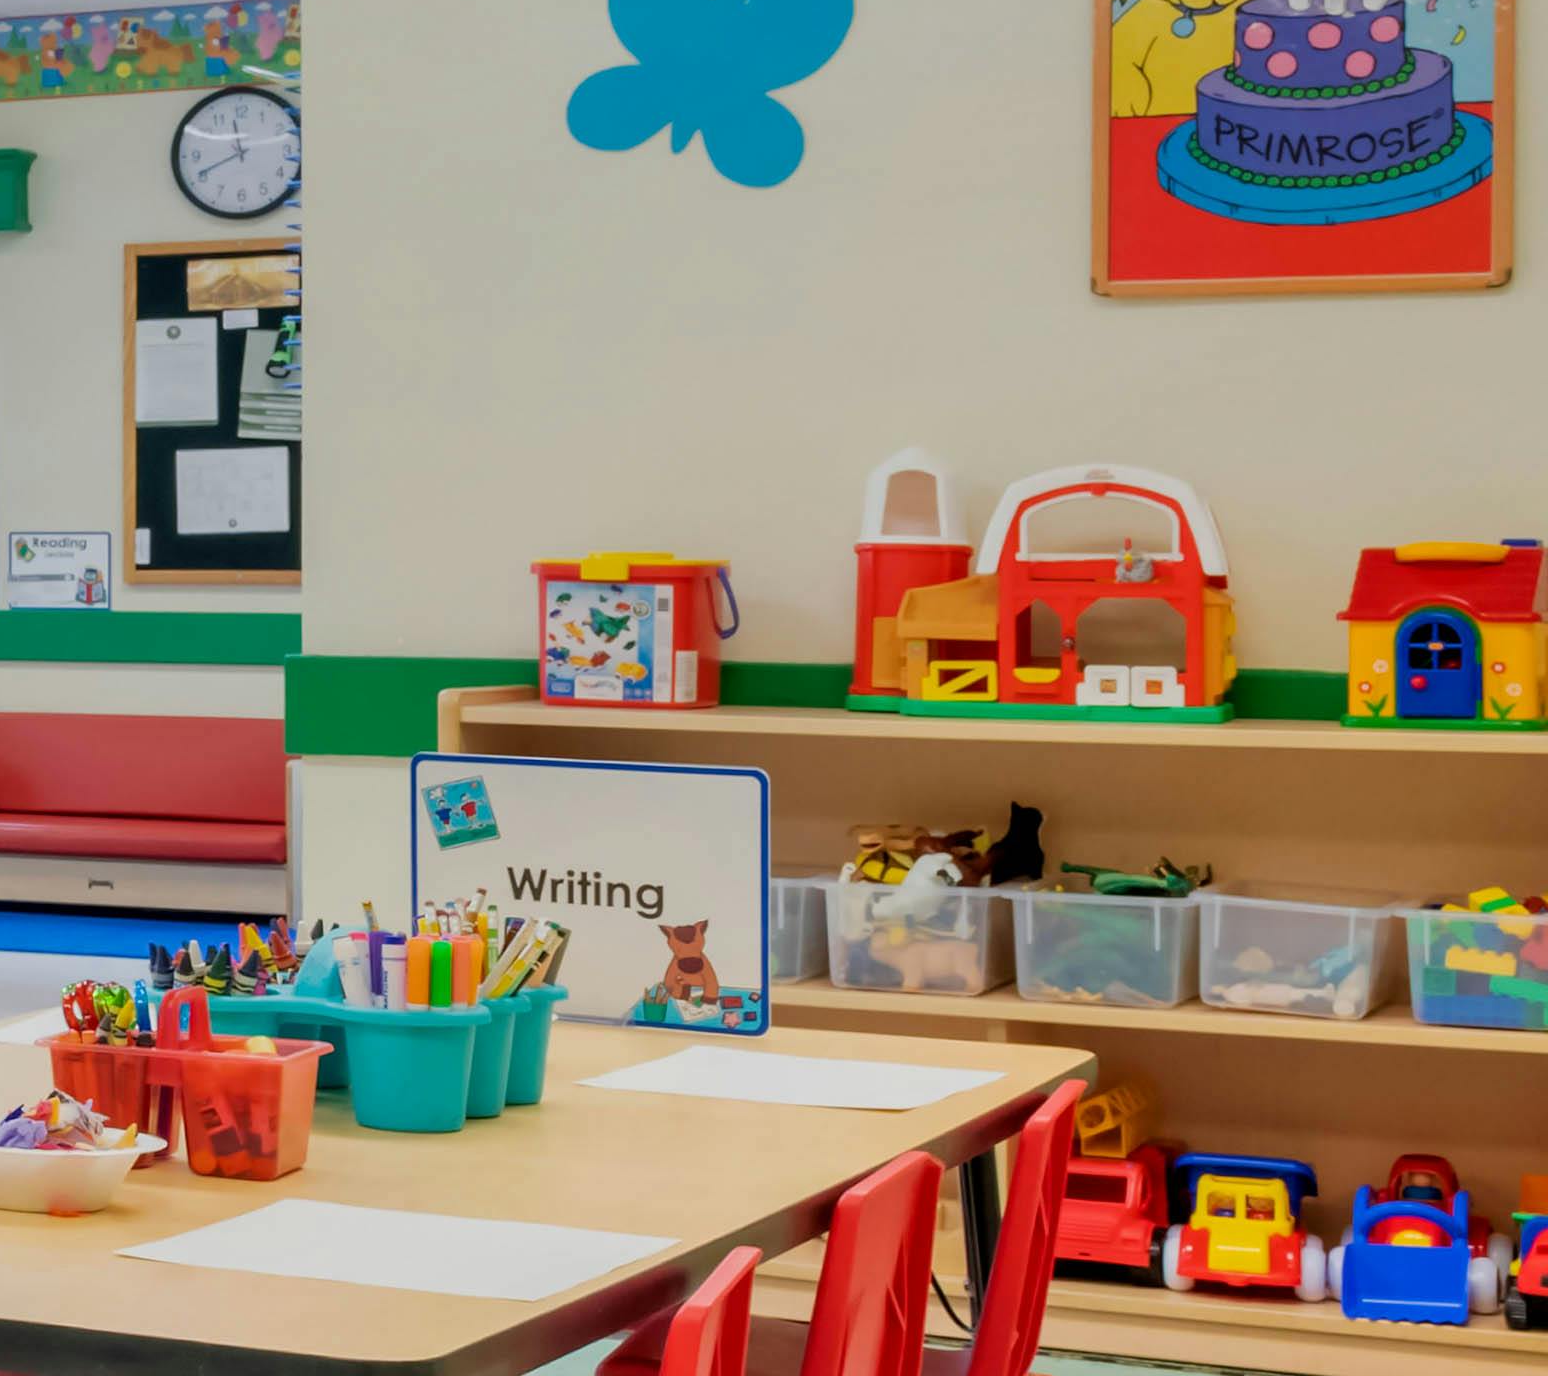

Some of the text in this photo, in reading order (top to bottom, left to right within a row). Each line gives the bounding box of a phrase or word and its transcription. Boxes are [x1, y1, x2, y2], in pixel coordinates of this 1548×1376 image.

[1214, 113, 1432, 167] PRIMROSE
[191, 150, 202, 161] 9
[237, 188, 246, 202] 6
[32, 537, 88, 550] Reading
[507, 866, 665, 919] Writing
